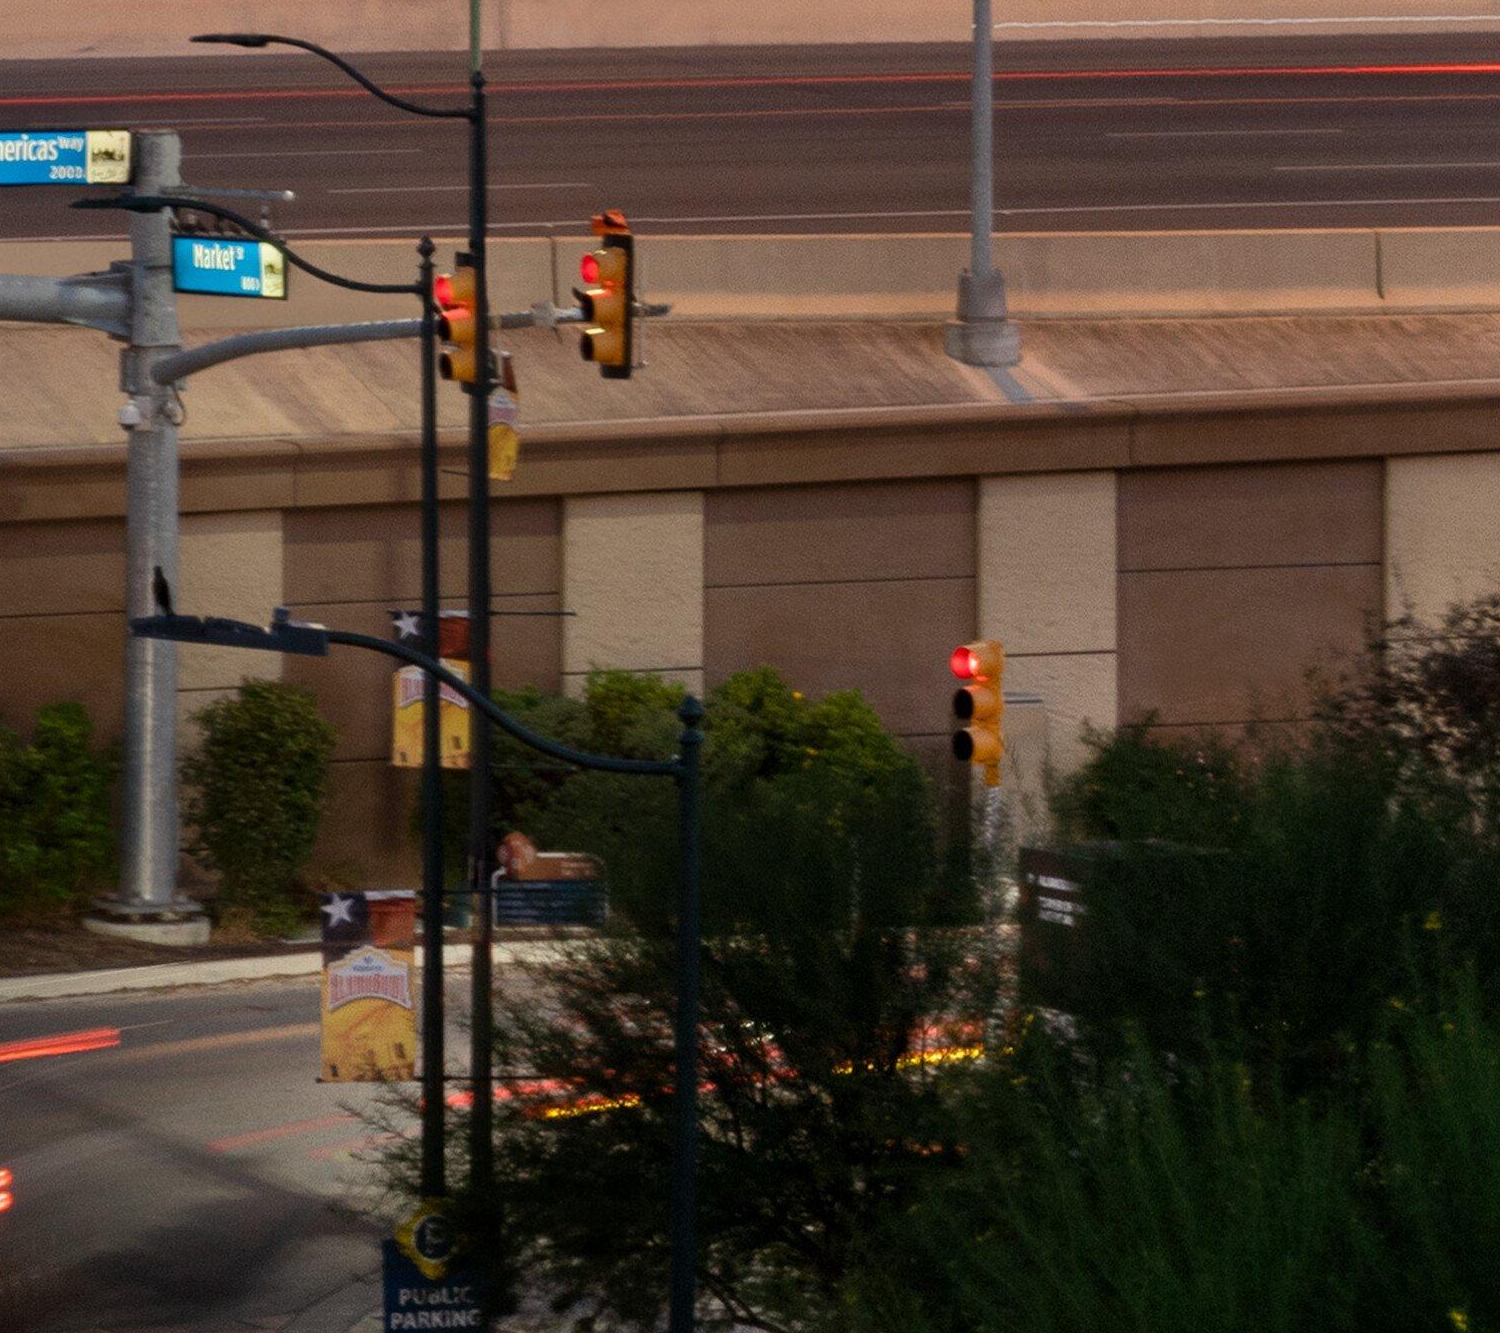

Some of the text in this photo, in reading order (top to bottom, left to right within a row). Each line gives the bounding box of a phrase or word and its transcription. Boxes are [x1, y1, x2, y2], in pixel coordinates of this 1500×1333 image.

[192, 242, 237, 271] Market
[399, 1286, 475, 1306] PUBLIC
[390, 1308, 482, 1330] PARKING
